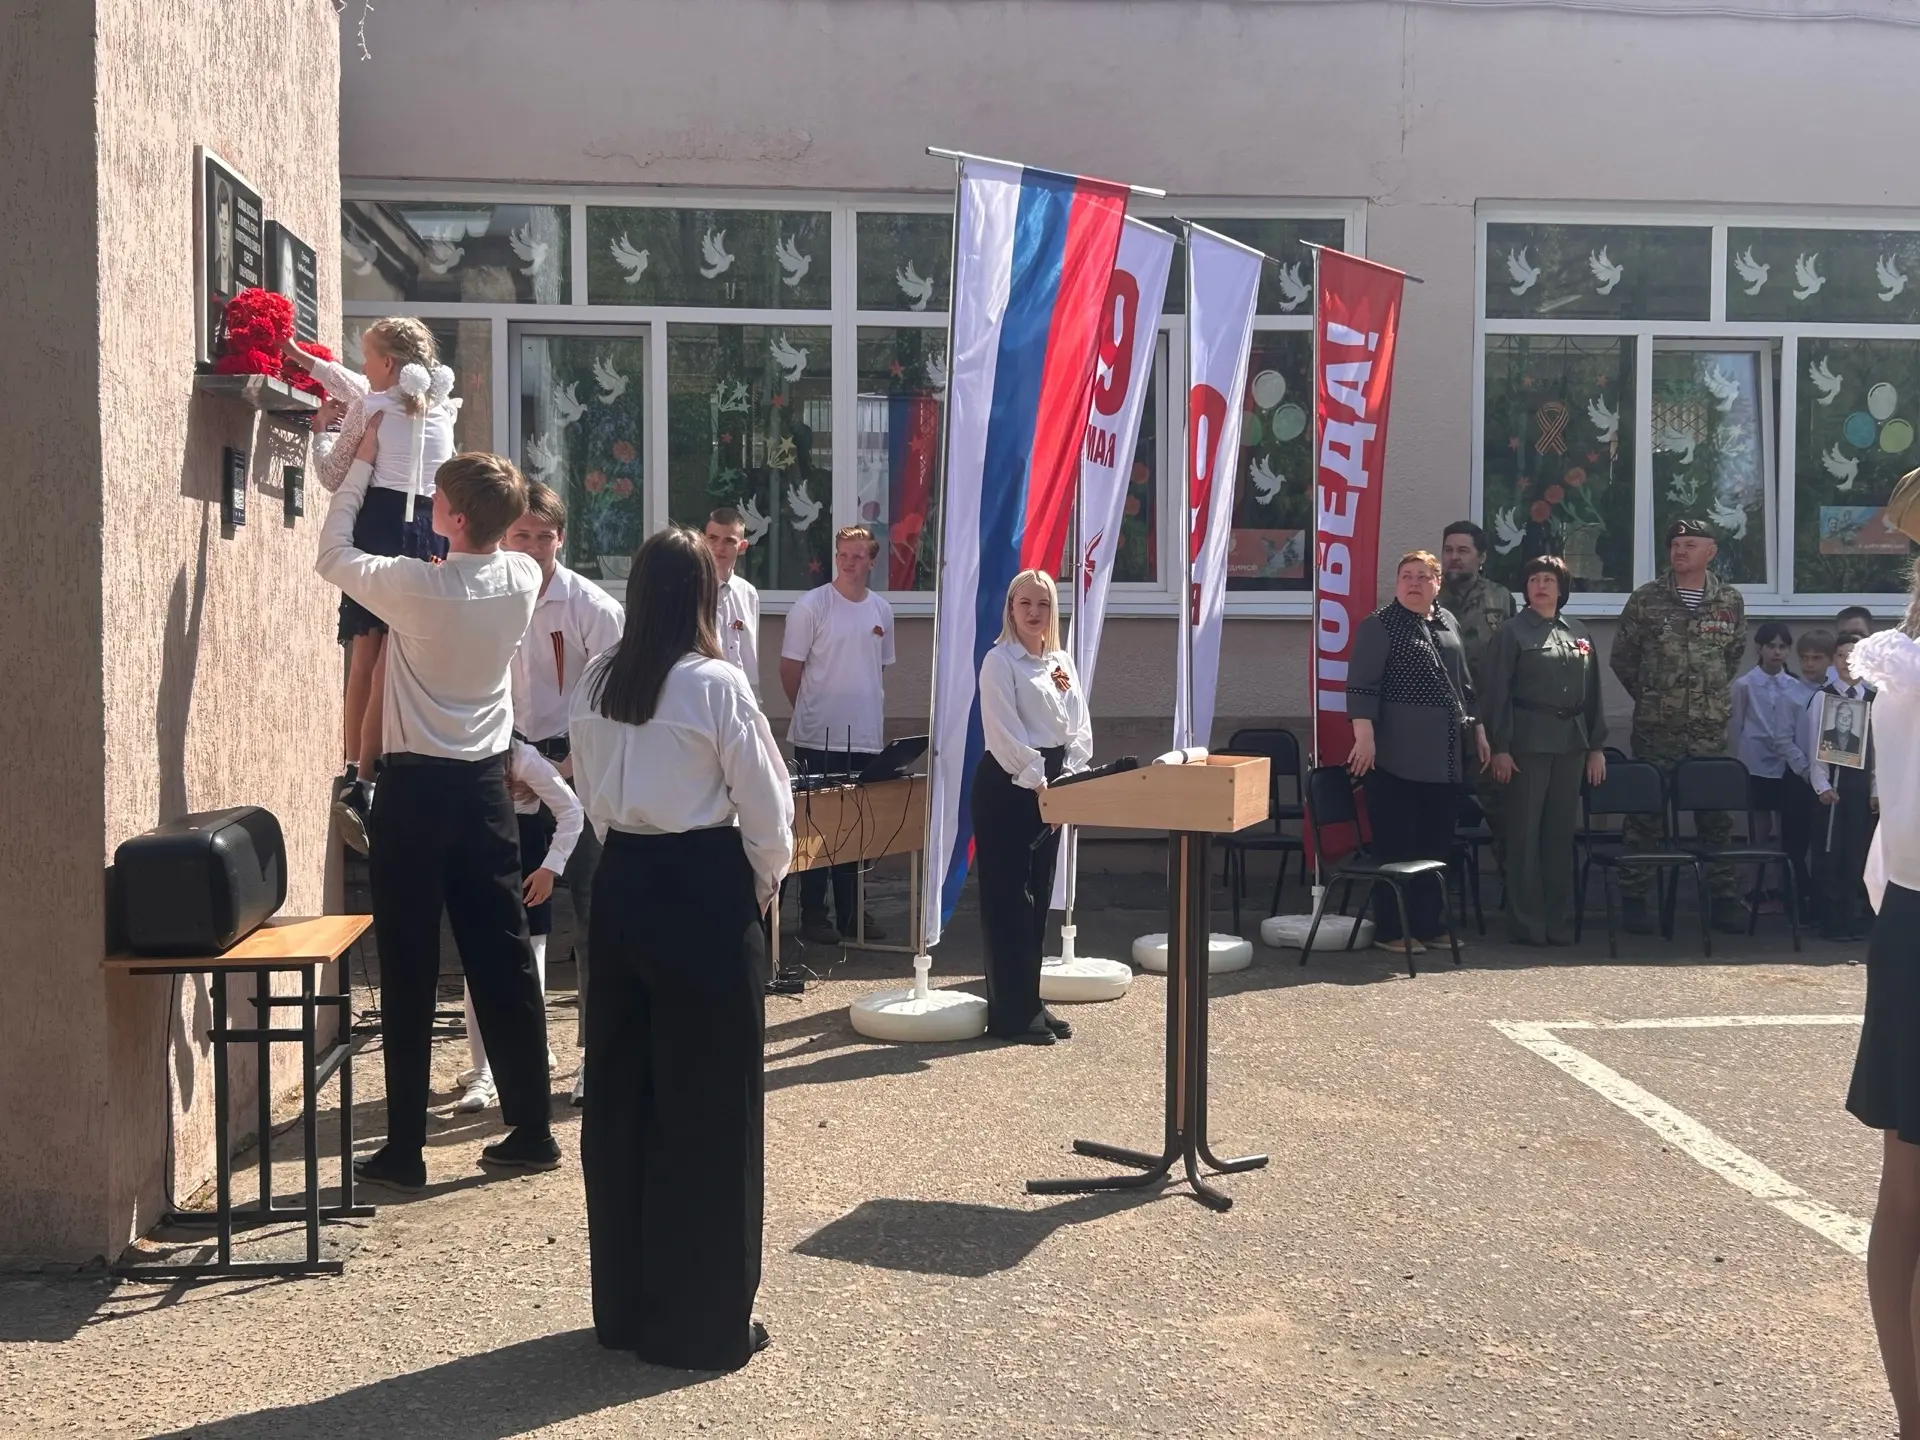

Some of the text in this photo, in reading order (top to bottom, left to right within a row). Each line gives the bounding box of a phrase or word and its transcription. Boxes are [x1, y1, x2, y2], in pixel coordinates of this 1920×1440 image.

[1094, 269, 1139, 416] 9
[1086, 424, 1116, 468] МАЯ
[1317, 321, 1379, 712] ПОБЕДА!
